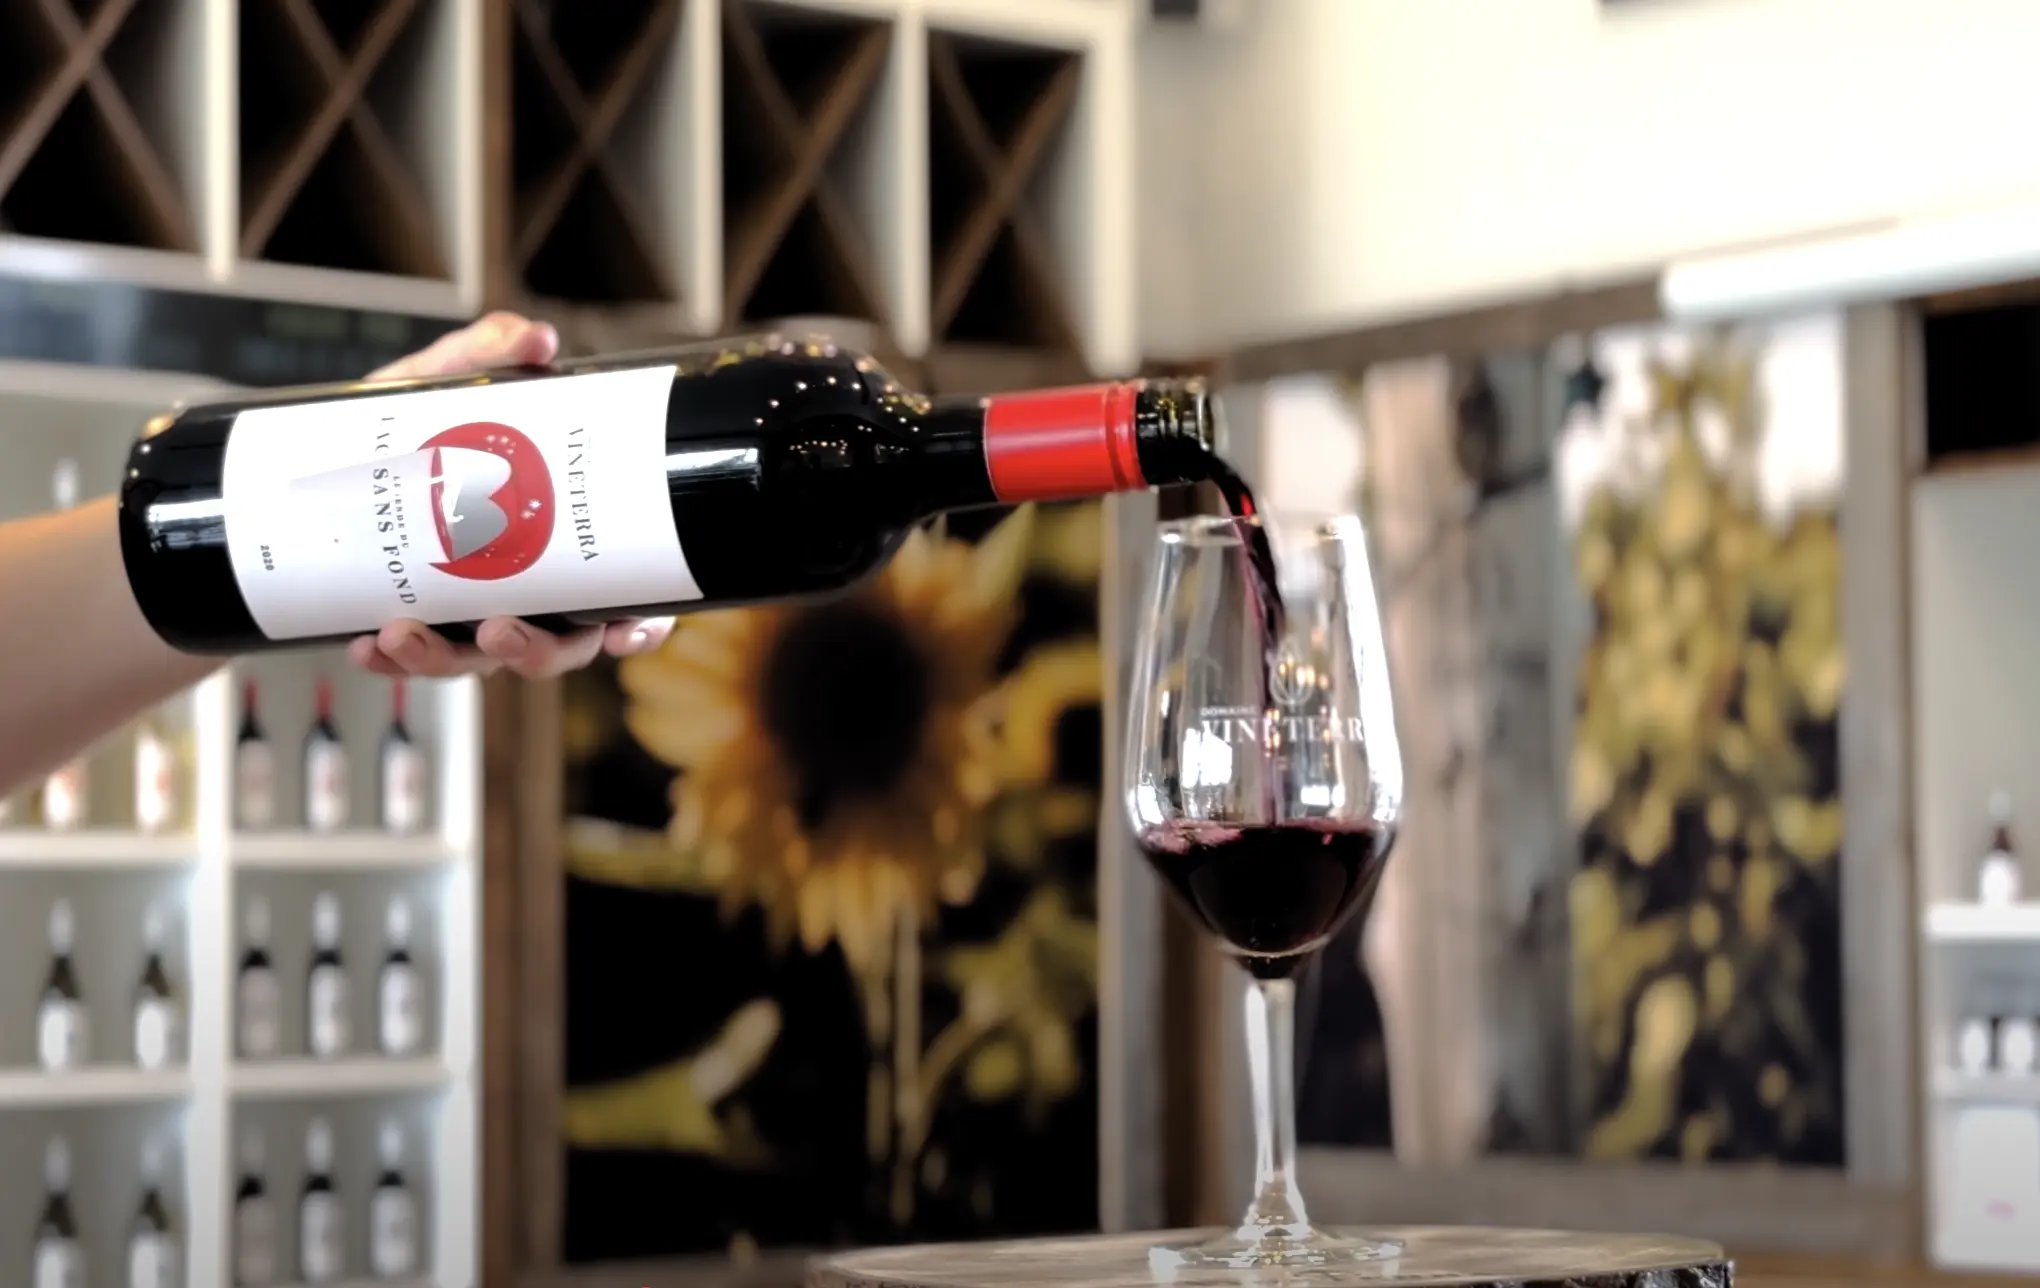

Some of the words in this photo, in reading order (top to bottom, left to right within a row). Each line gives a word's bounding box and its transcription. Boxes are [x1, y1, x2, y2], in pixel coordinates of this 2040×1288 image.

[260, 544, 275, 571] 2020
[372, 467, 394, 533] SANS
[383, 544, 418, 606] FOND
[567, 427, 600, 562] VINETERRA
